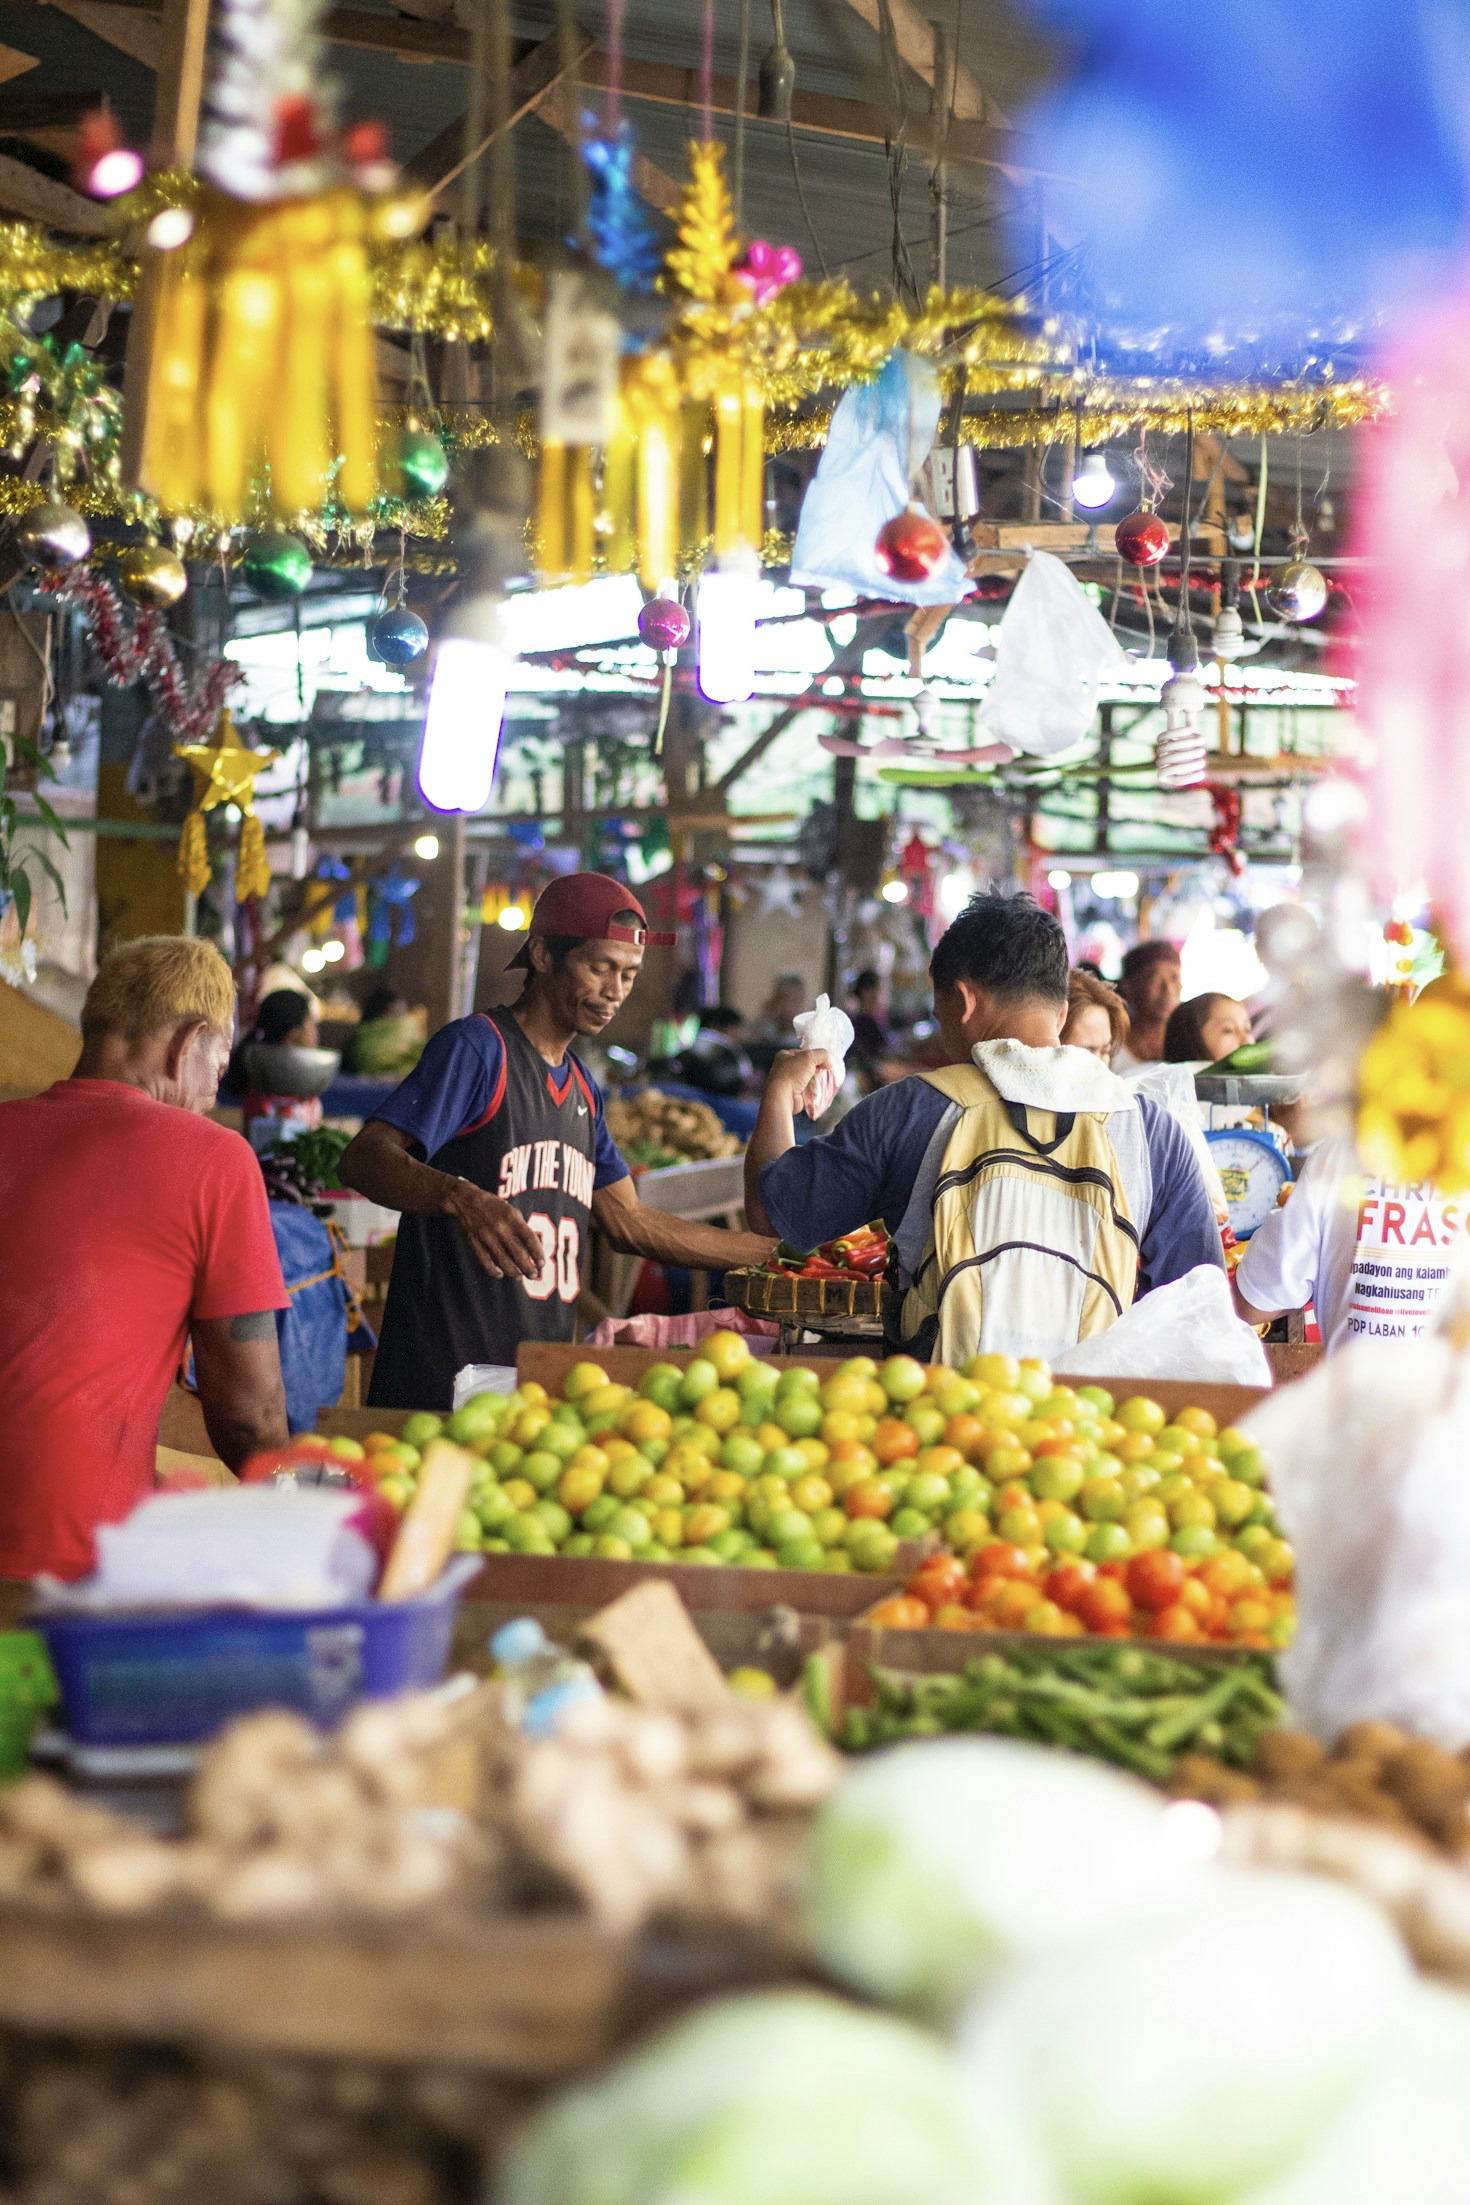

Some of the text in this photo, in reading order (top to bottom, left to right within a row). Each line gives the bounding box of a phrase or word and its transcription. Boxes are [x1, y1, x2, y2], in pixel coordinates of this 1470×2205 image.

[533, 1140, 560, 1190] THE
[563, 1143, 596, 1210] YOUN
[522, 1211, 580, 1303] 30
[1395, 1267, 1413, 1280] ang
[1355, 1282, 1425, 1301] Nagkahiusang
[1348, 1317, 1366, 1333] PDP
[1369, 1322, 1405, 1337] LABAN
